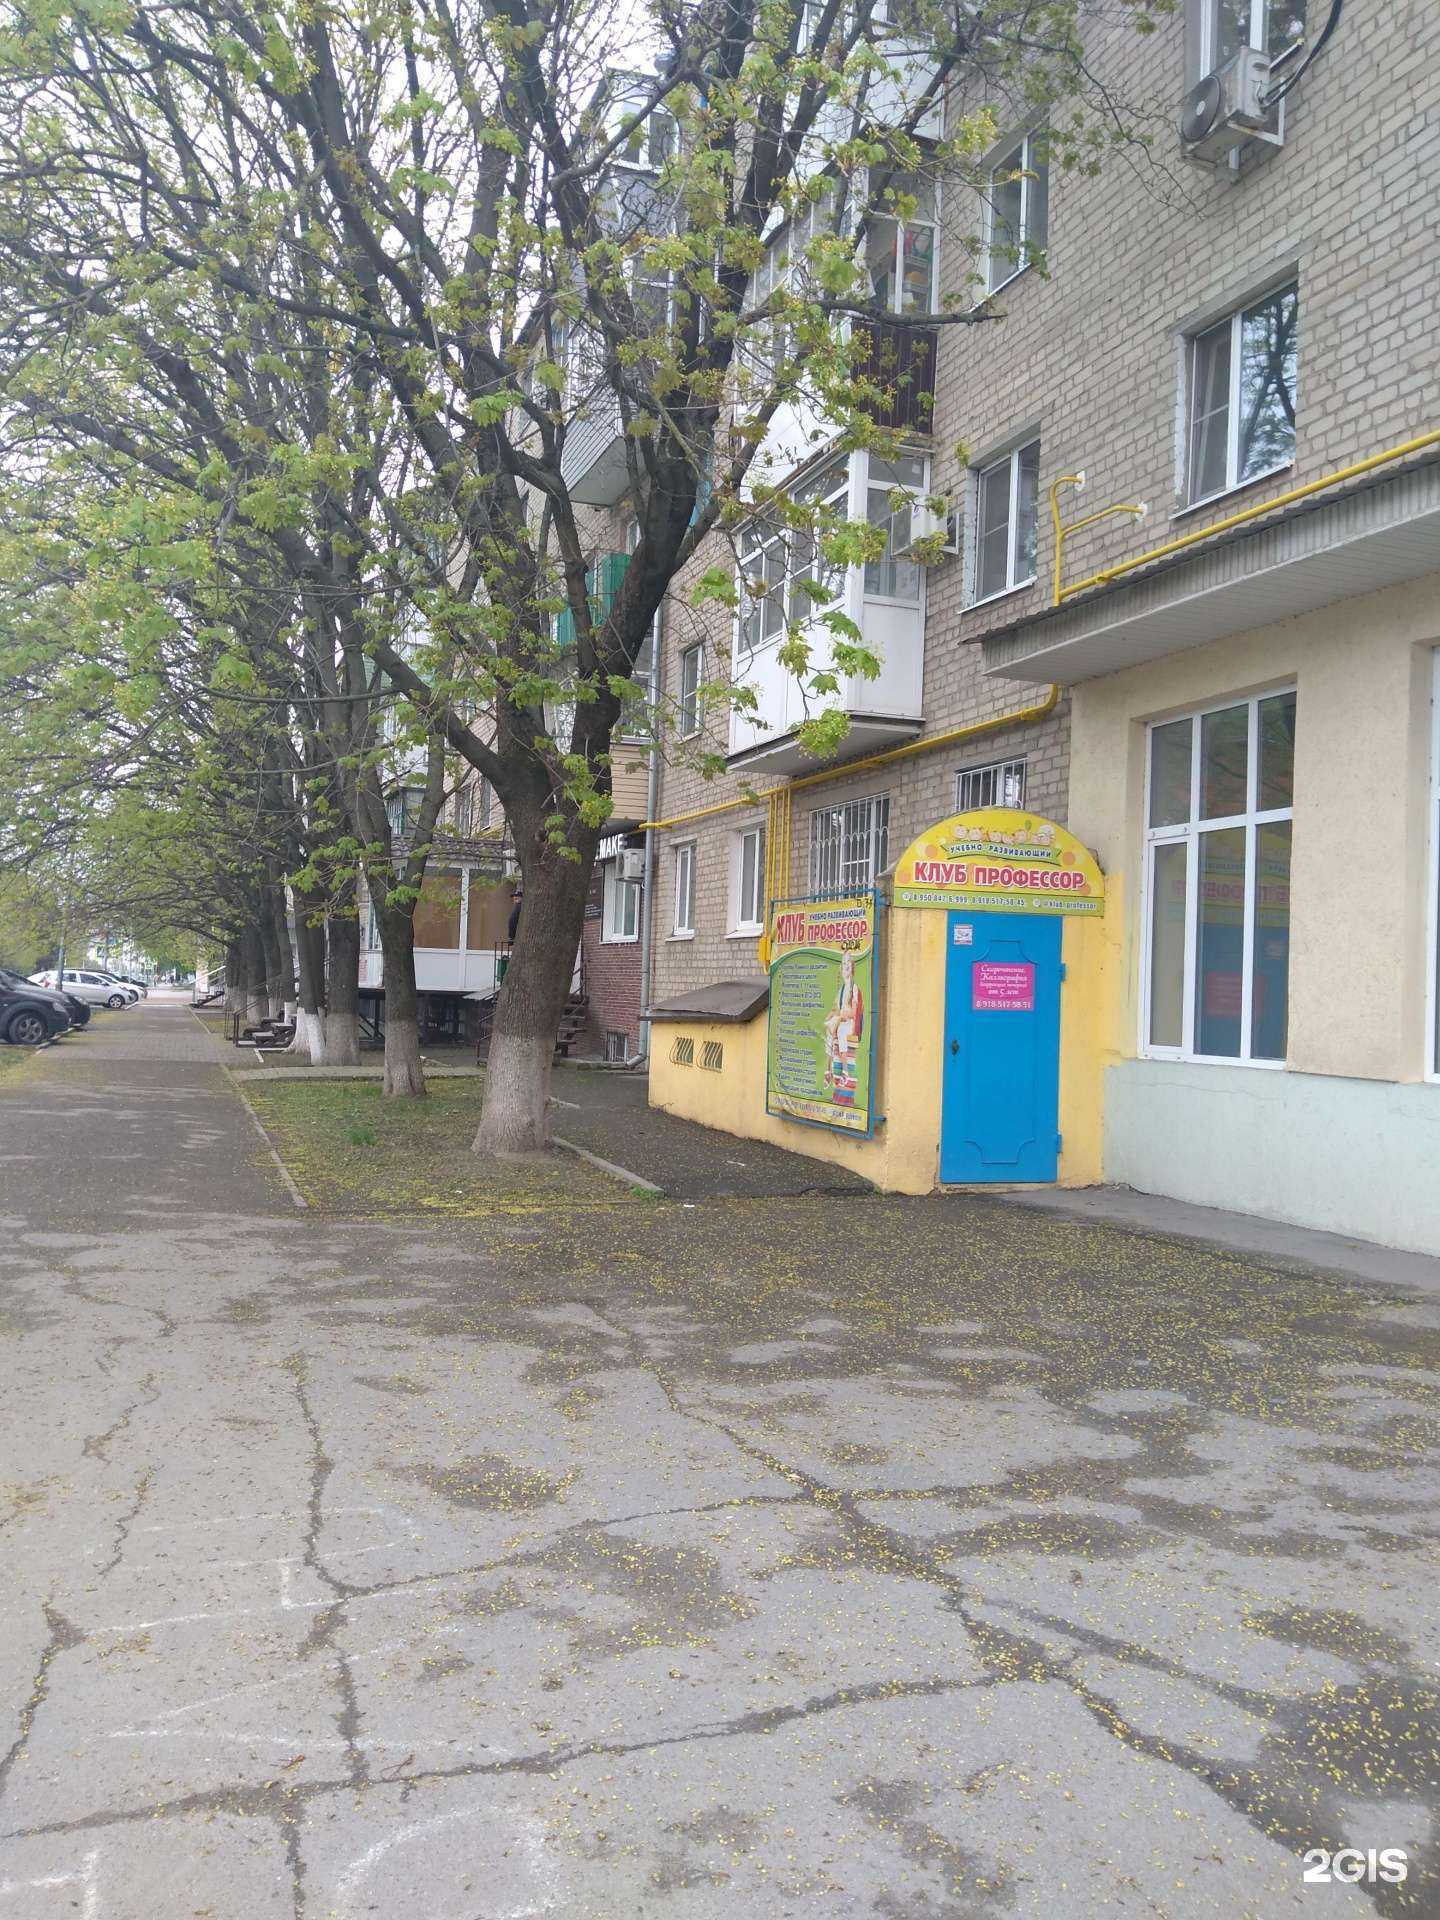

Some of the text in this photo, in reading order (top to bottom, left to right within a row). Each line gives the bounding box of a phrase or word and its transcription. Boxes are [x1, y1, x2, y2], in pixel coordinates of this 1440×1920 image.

[950, 844, 982, 854] УЧЕБНО
[914, 862, 1085, 889] КЛУБ ПРОФЕССОР
[776, 912, 868, 944] КЛУБ ПРОФЕССОР
